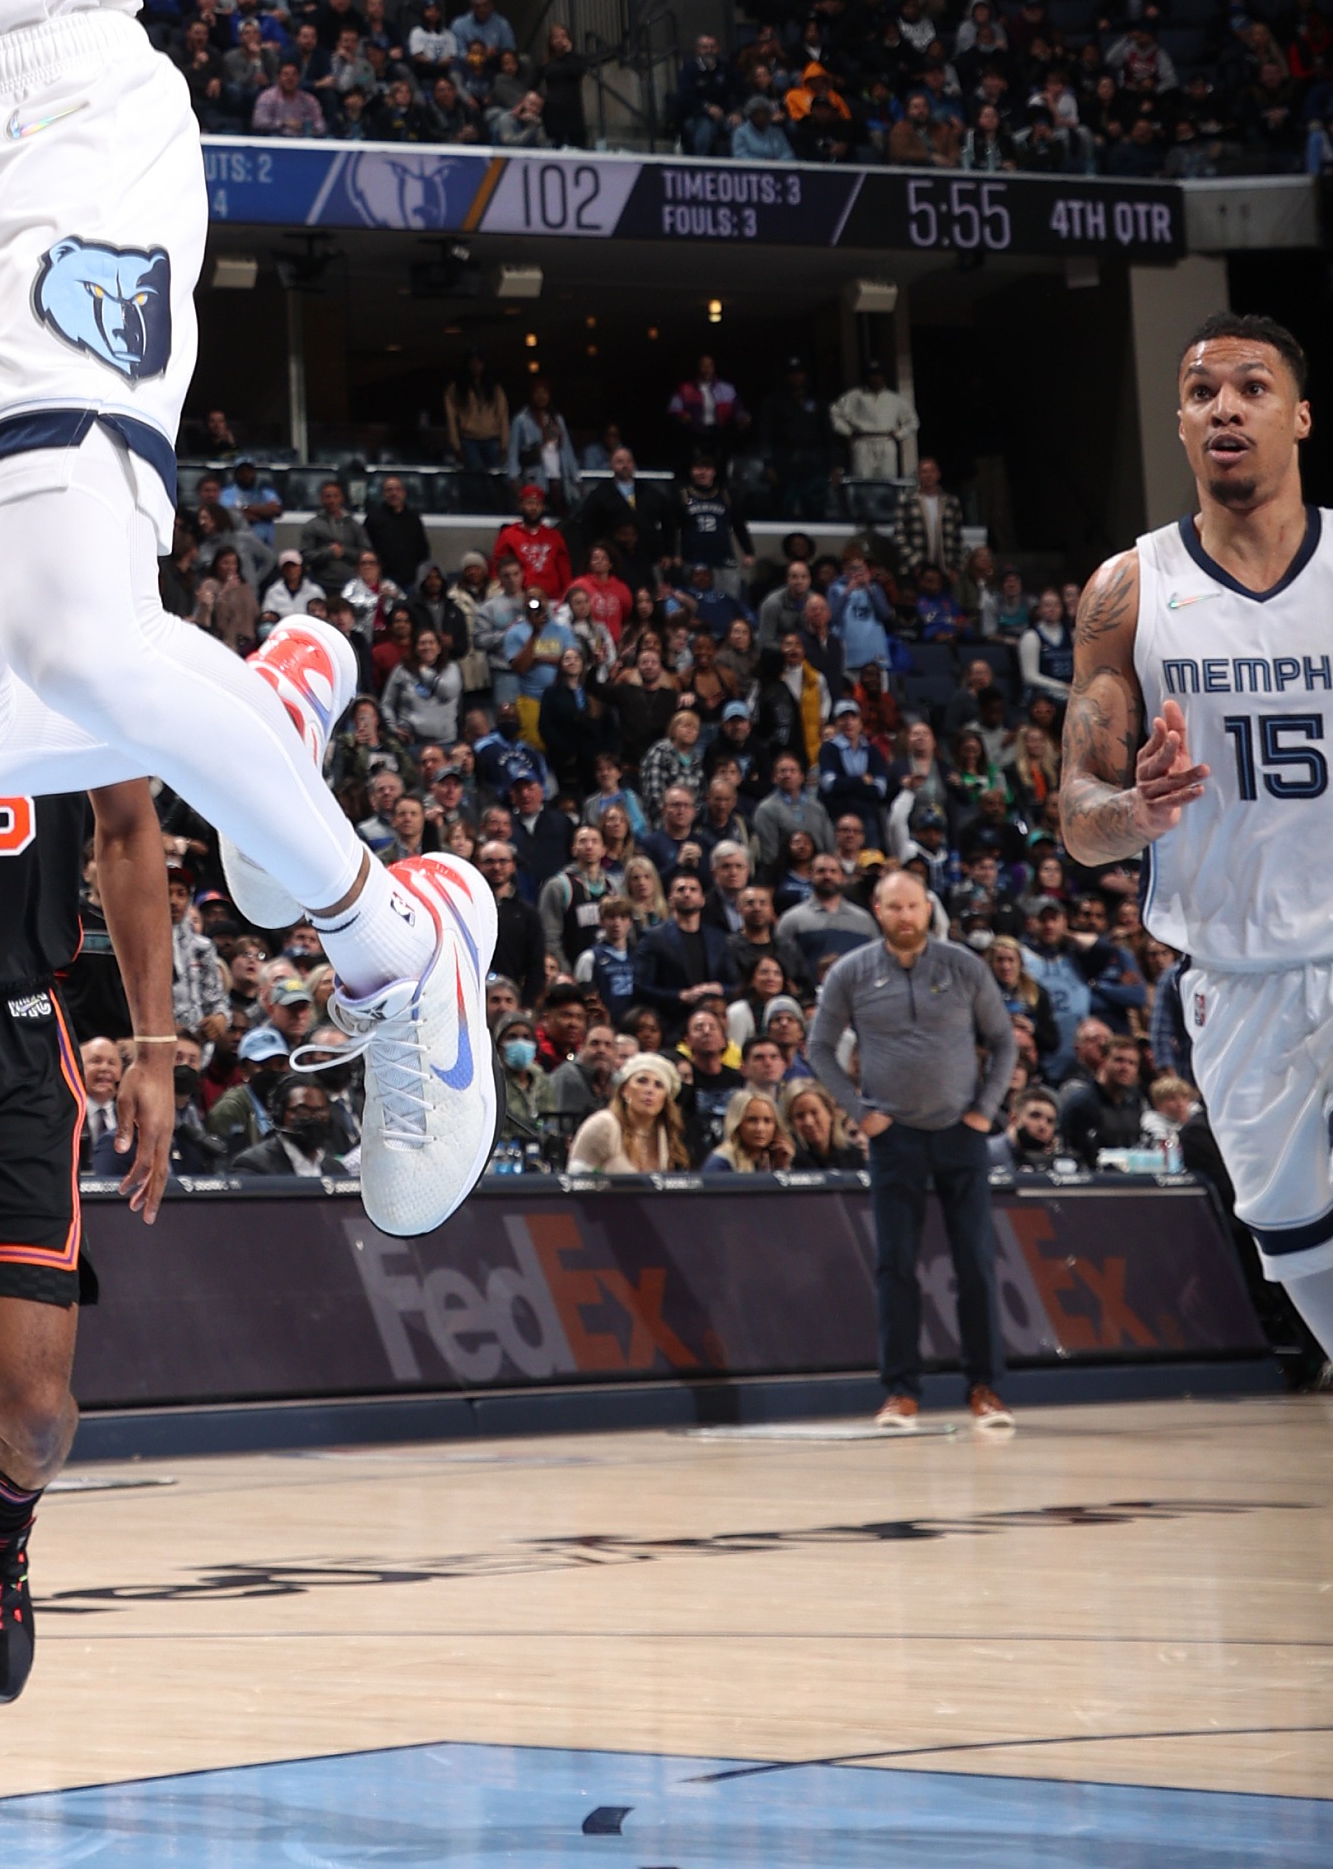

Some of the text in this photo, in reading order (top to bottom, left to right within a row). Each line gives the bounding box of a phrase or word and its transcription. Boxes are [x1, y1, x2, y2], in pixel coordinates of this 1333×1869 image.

[522, 163, 603, 231] 102
[662, 168, 802, 206] TIMEOUTS: 3
[907, 178, 1012, 251] 5:55
[662, 203, 759, 239] FOULS: 3
[1049, 198, 1174, 248] 4TH QTR
[1162, 655, 1333, 695] MEMPH
[1224, 712, 1329, 802] 15
[341, 1213, 702, 1382] FedEx
